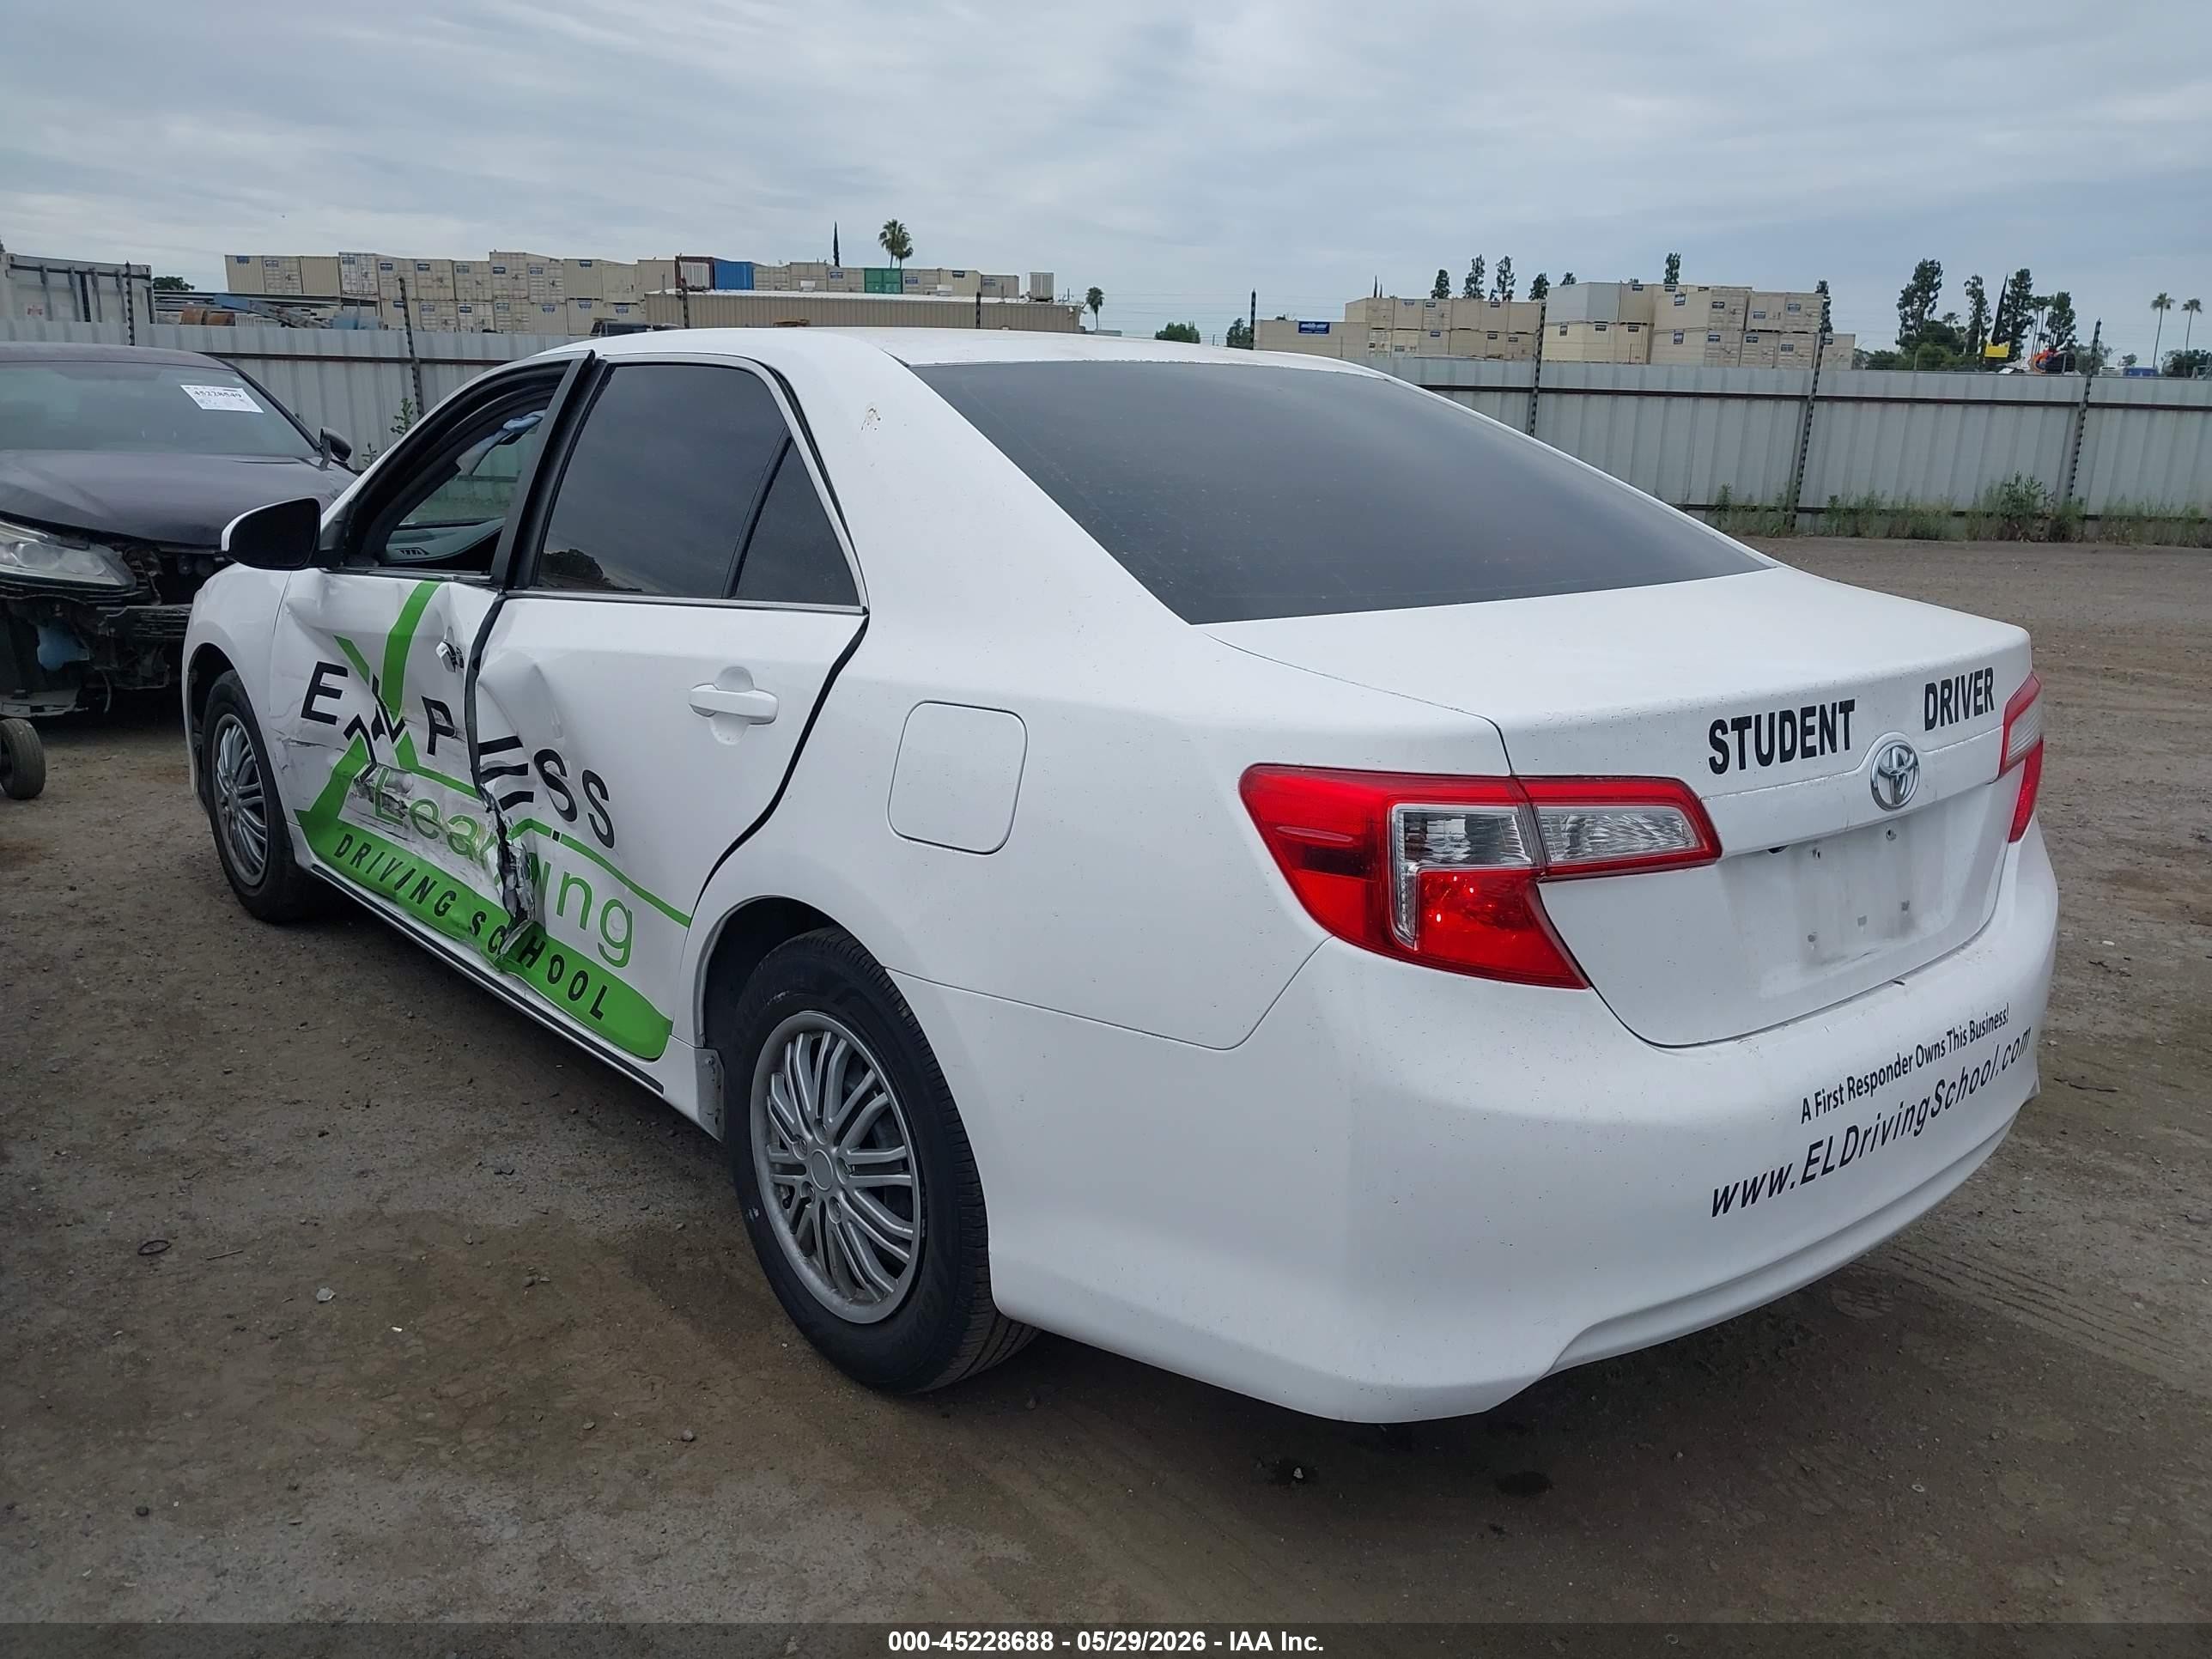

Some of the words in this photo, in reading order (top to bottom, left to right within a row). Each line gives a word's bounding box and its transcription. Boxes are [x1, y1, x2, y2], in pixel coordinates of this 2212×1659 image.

[301, 660, 615, 848] EXPESS
[1708, 698, 1856, 775] STUDENT
[1923, 666, 1995, 732] DRIVER
[333, 833, 457, 918] DRIVING
[470, 910, 605, 1021] SCHOOL
[1711, 1025, 2032, 1217] www.ELDrivingSchool.com
[1801, 1097, 1813, 1124] A
[1814, 1087, 1845, 1118] First
[1847, 1053, 1913, 1103] Responder
[1916, 1038, 1946, 1068] Owns
[1947, 1024, 1968, 1054] This
[1969, 1003, 2009, 1043] Business!
